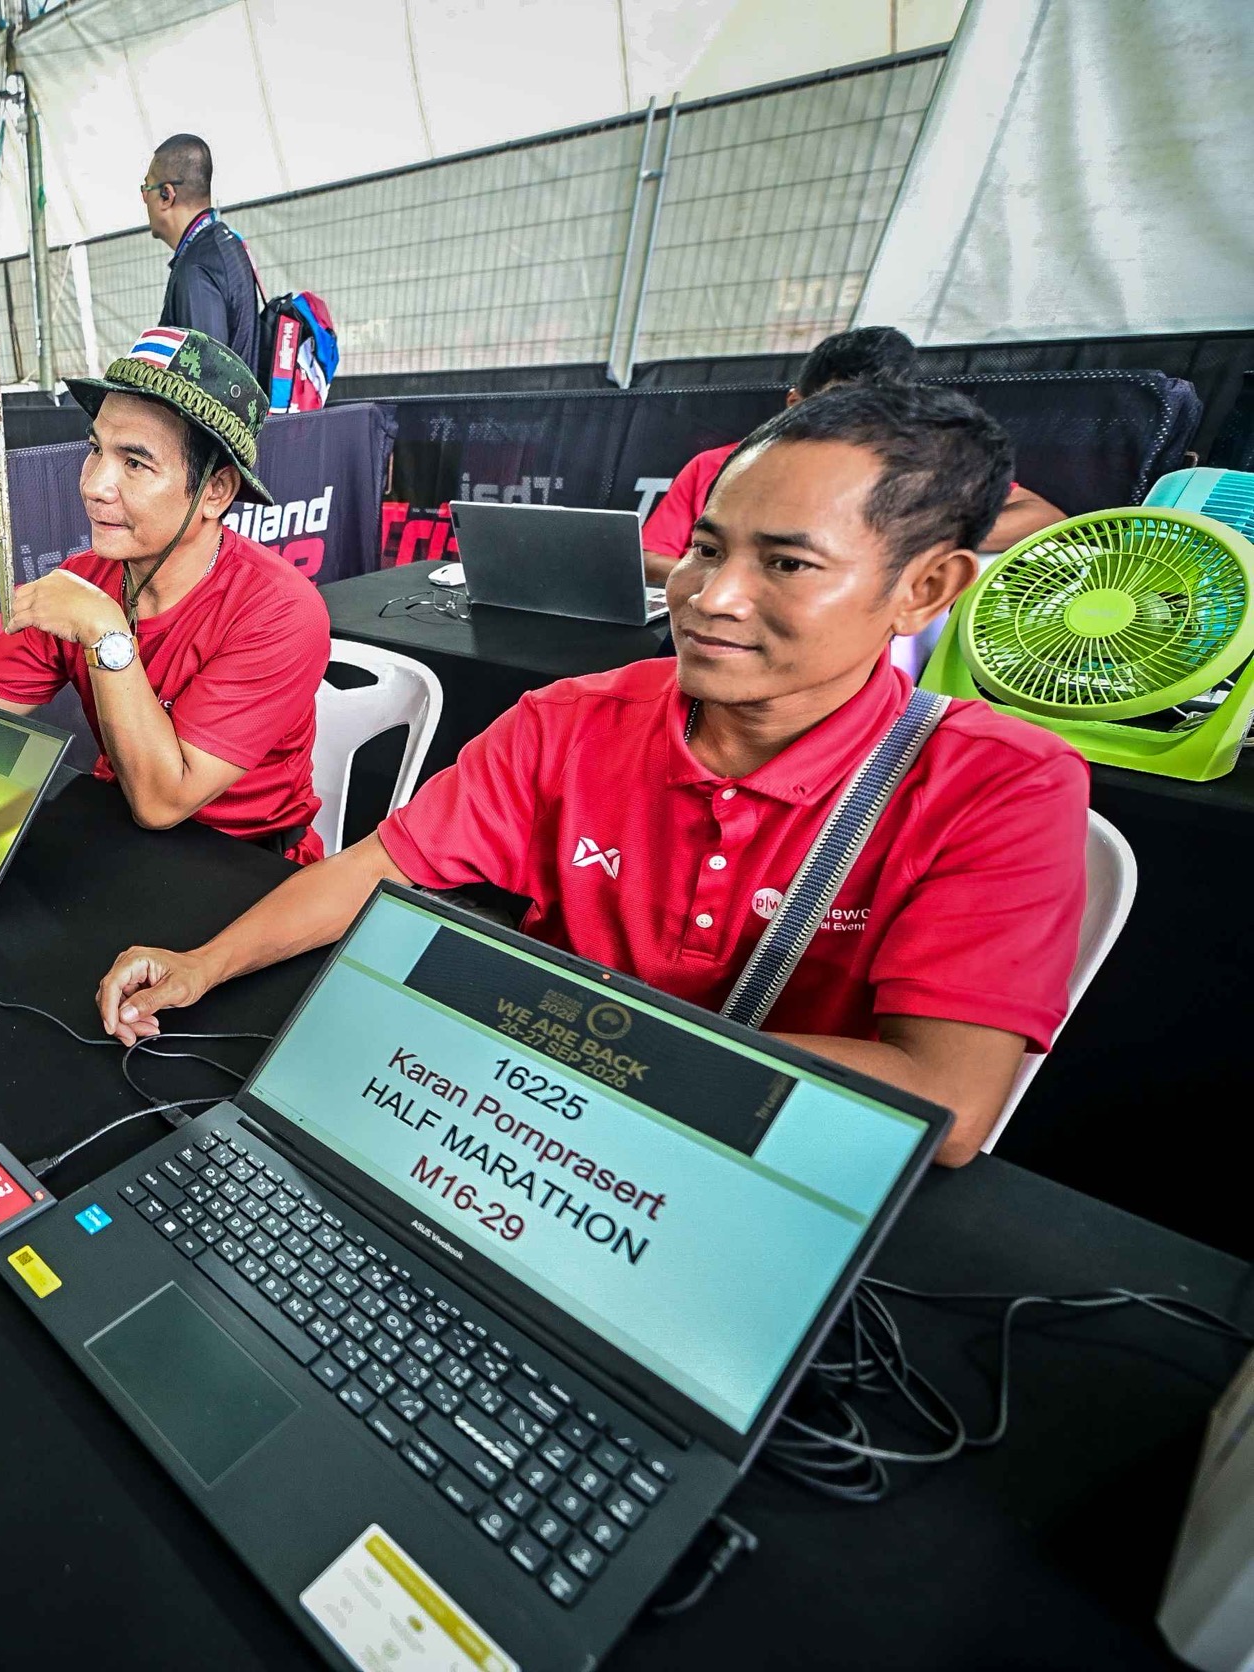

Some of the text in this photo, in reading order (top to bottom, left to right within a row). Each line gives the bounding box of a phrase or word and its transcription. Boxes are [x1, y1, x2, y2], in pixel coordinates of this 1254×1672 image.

[222, 486, 334, 543] ailand
[834, 922, 866, 932] Event
[496, 998, 651, 1081] WE ARE BACK
[498, 1017, 628, 1090] 26-27 SEP 2026
[493, 1058, 590, 1121] 16225
[387, 1047, 668, 1221] Karan Pornprasert
[361, 1077, 650, 1267] HALF MARATHON
[409, 1154, 527, 1243] M16-29
[410, 1219, 465, 1261] ASUS Vivobook
